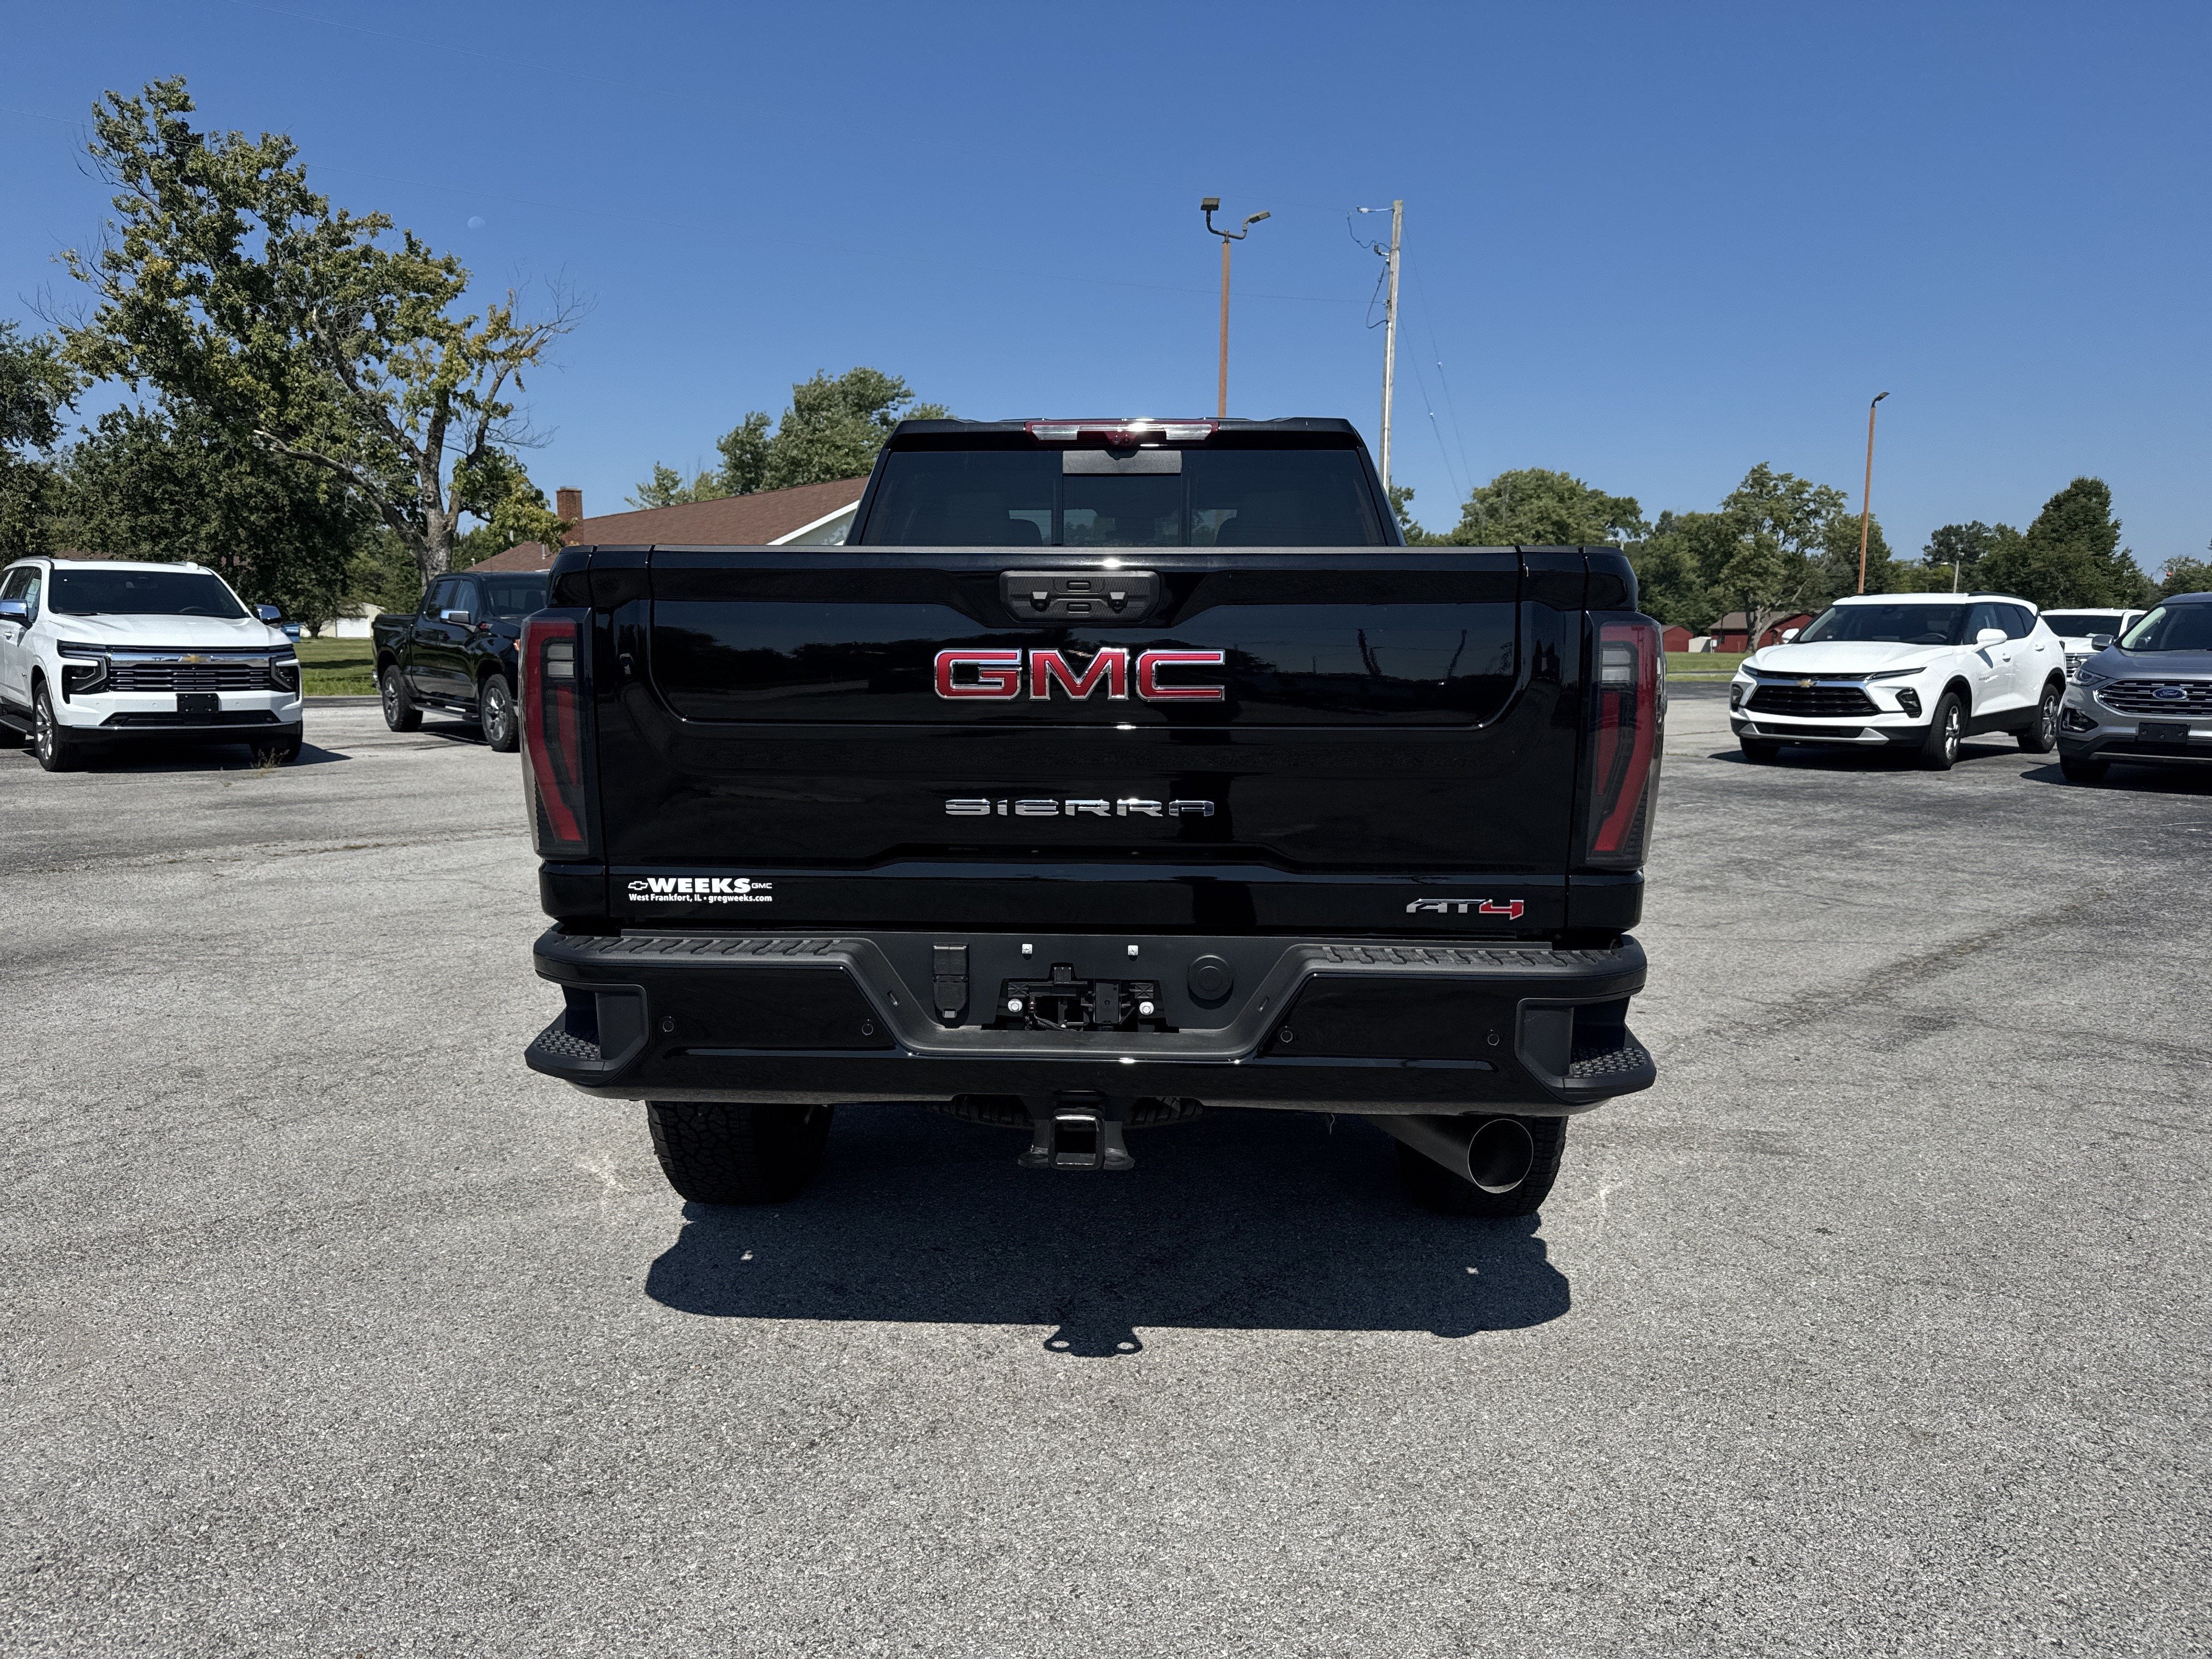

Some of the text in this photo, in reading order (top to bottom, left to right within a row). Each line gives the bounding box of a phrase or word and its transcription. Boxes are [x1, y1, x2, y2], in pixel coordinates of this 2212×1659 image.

[934, 648, 1225, 702] GMC
[945, 799, 1214, 816] SIERRA
[647, 878, 751, 893] WEEKS
[650, 894, 692, 902] Frankfort,
[708, 894, 772, 904] gregweeks.com
[1406, 899, 1524, 920] AT4
